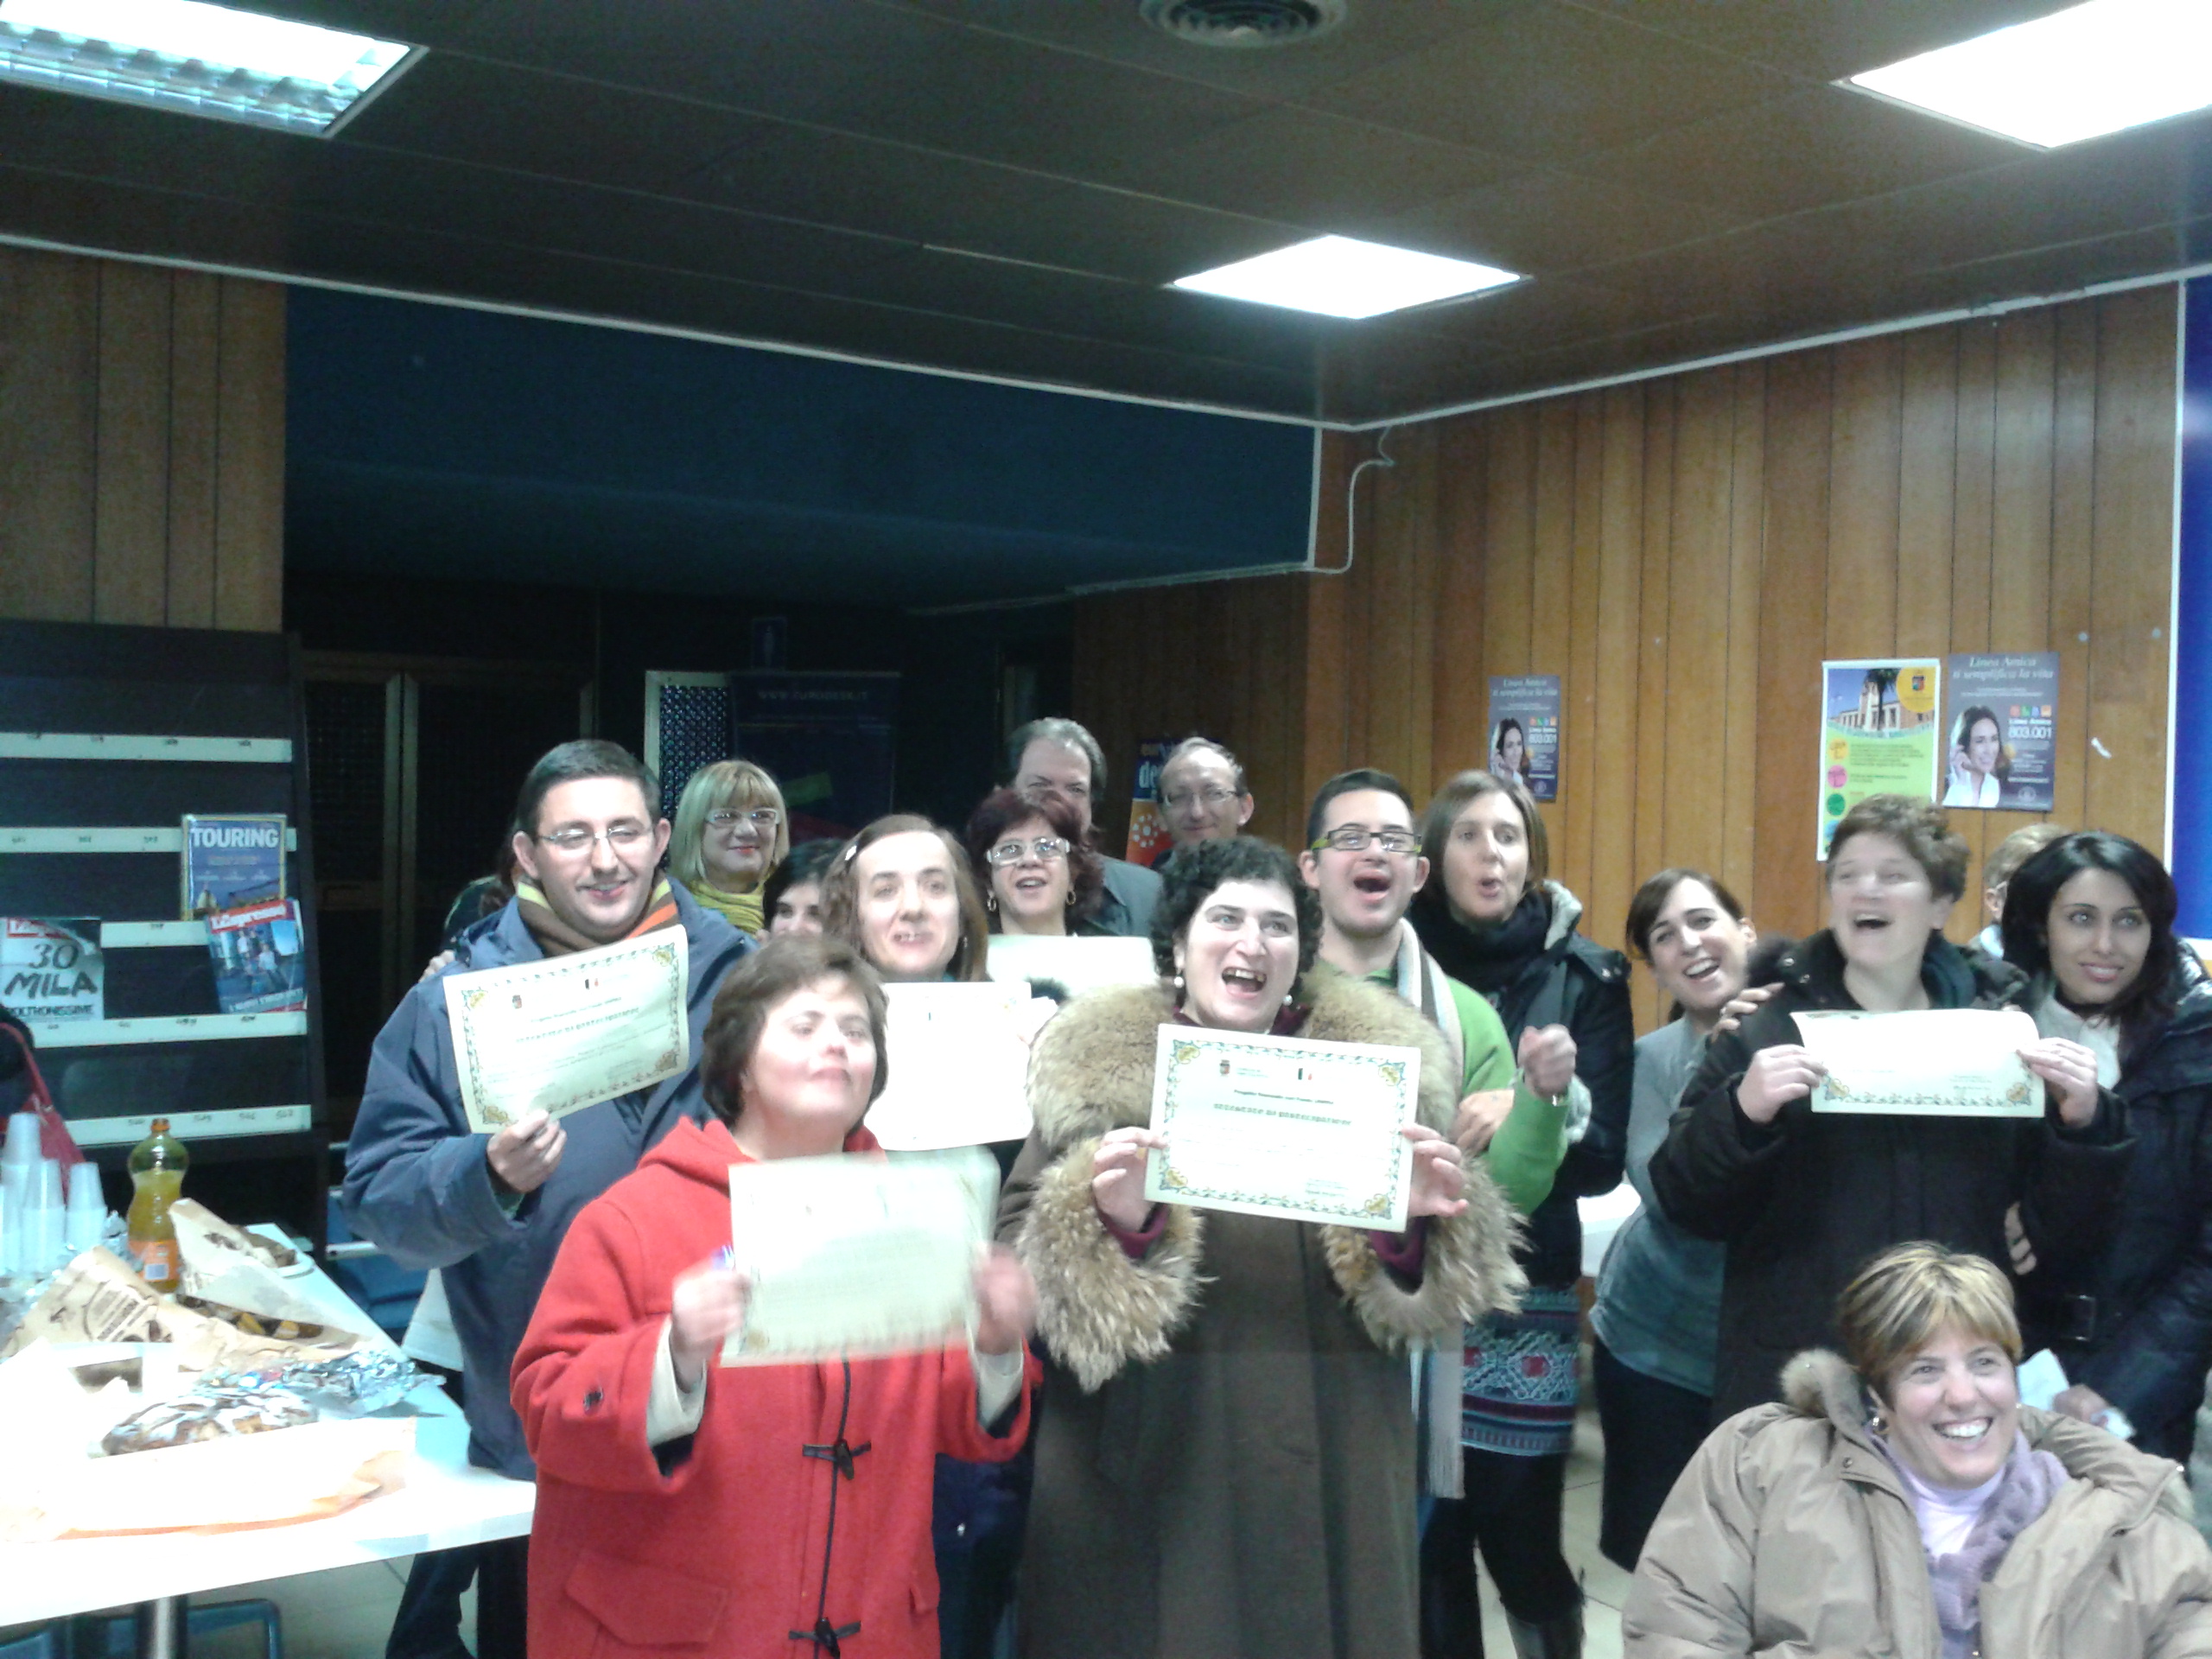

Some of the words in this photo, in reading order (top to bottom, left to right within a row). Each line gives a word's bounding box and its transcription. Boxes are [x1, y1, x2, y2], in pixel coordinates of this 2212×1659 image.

[2008, 726, 2052, 739] 803.001
[190, 827, 279, 849] TOURING
[28, 944, 80, 969] 30
[3, 969, 99, 1000] MILA
